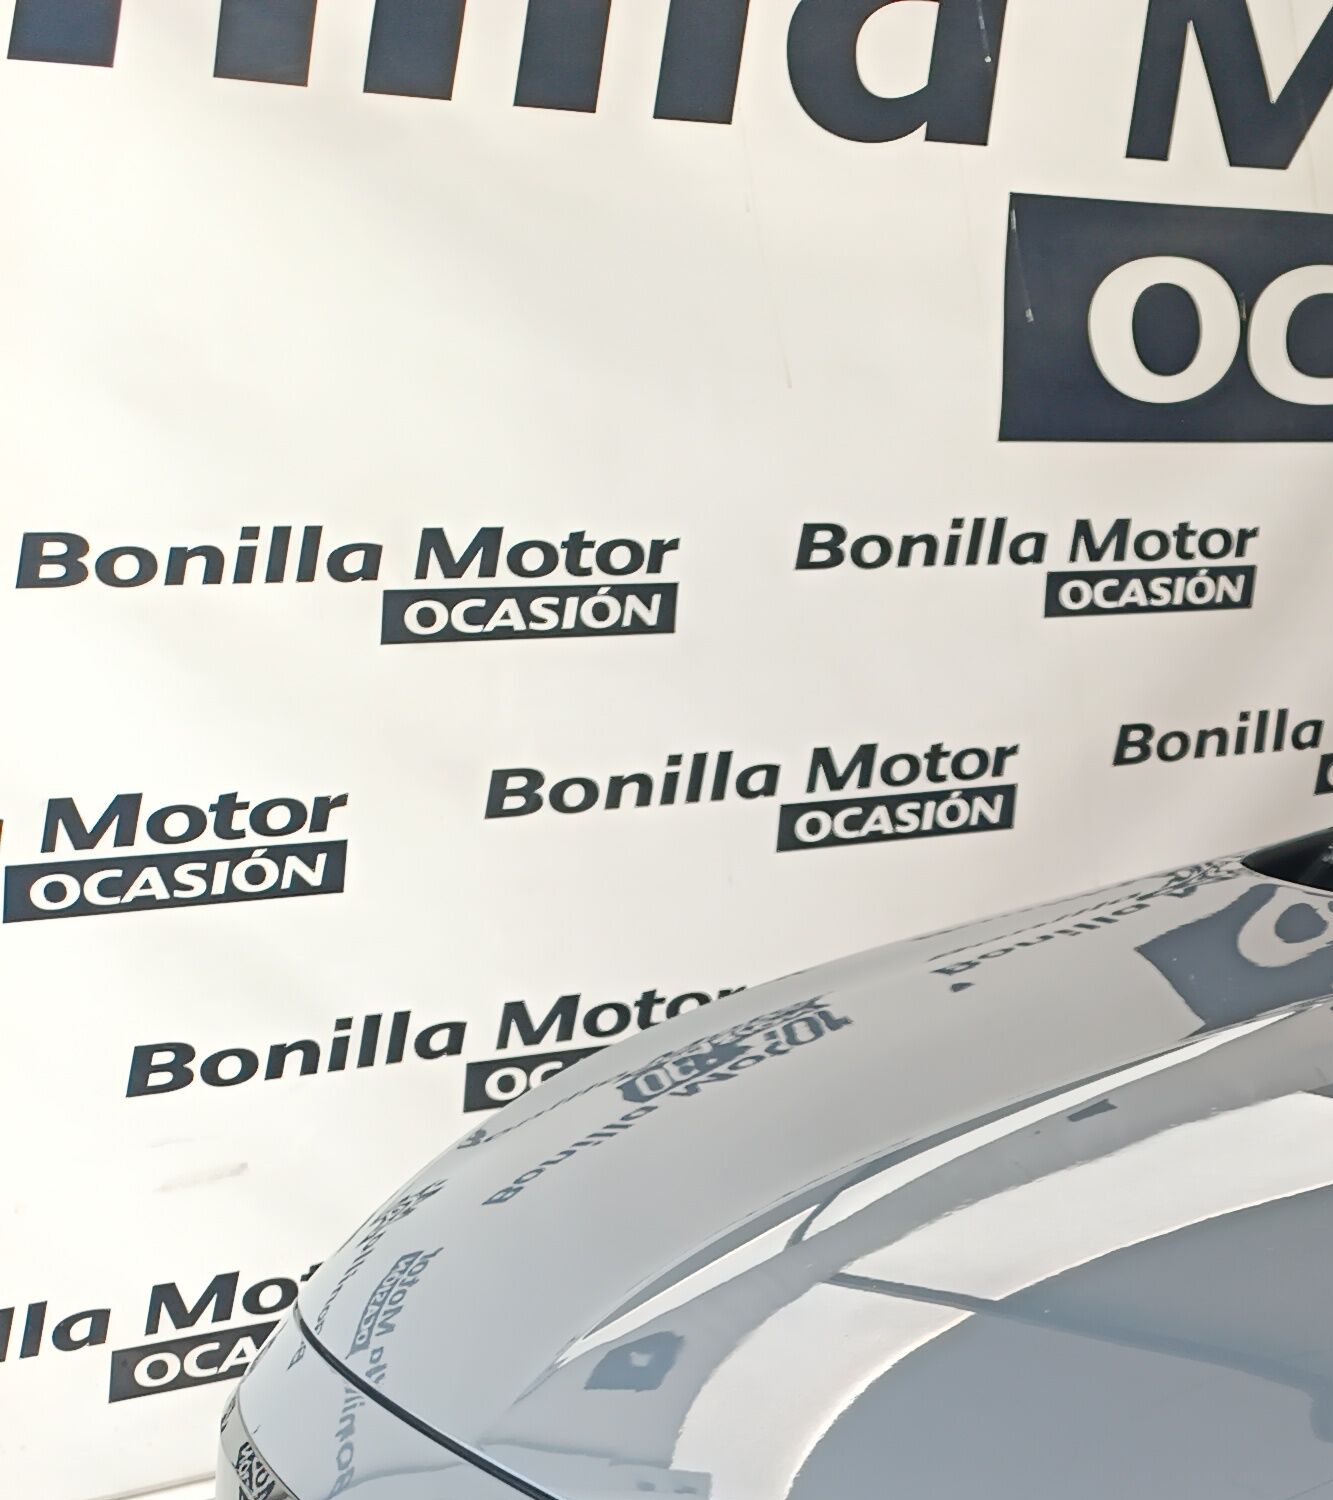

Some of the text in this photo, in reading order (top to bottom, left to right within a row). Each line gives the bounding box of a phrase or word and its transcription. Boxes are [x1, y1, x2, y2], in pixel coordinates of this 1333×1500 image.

[15, 525, 681, 590] Bonilla Motor
[795, 517, 1260, 571] Bonilla Motor
[402, 587, 664, 636] OCASIÓN
[1058, 570, 1247, 611] OCASIÓN
[1111, 708, 1325, 766] Bonilla
[484, 742, 1020, 819] Bonilla Motor
[40, 792, 349, 854] Motor
[794, 790, 1005, 845] OCASIÓN
[28, 849, 328, 912] OCASIÓN
[125, 985, 747, 1098] Bonilla Moto
